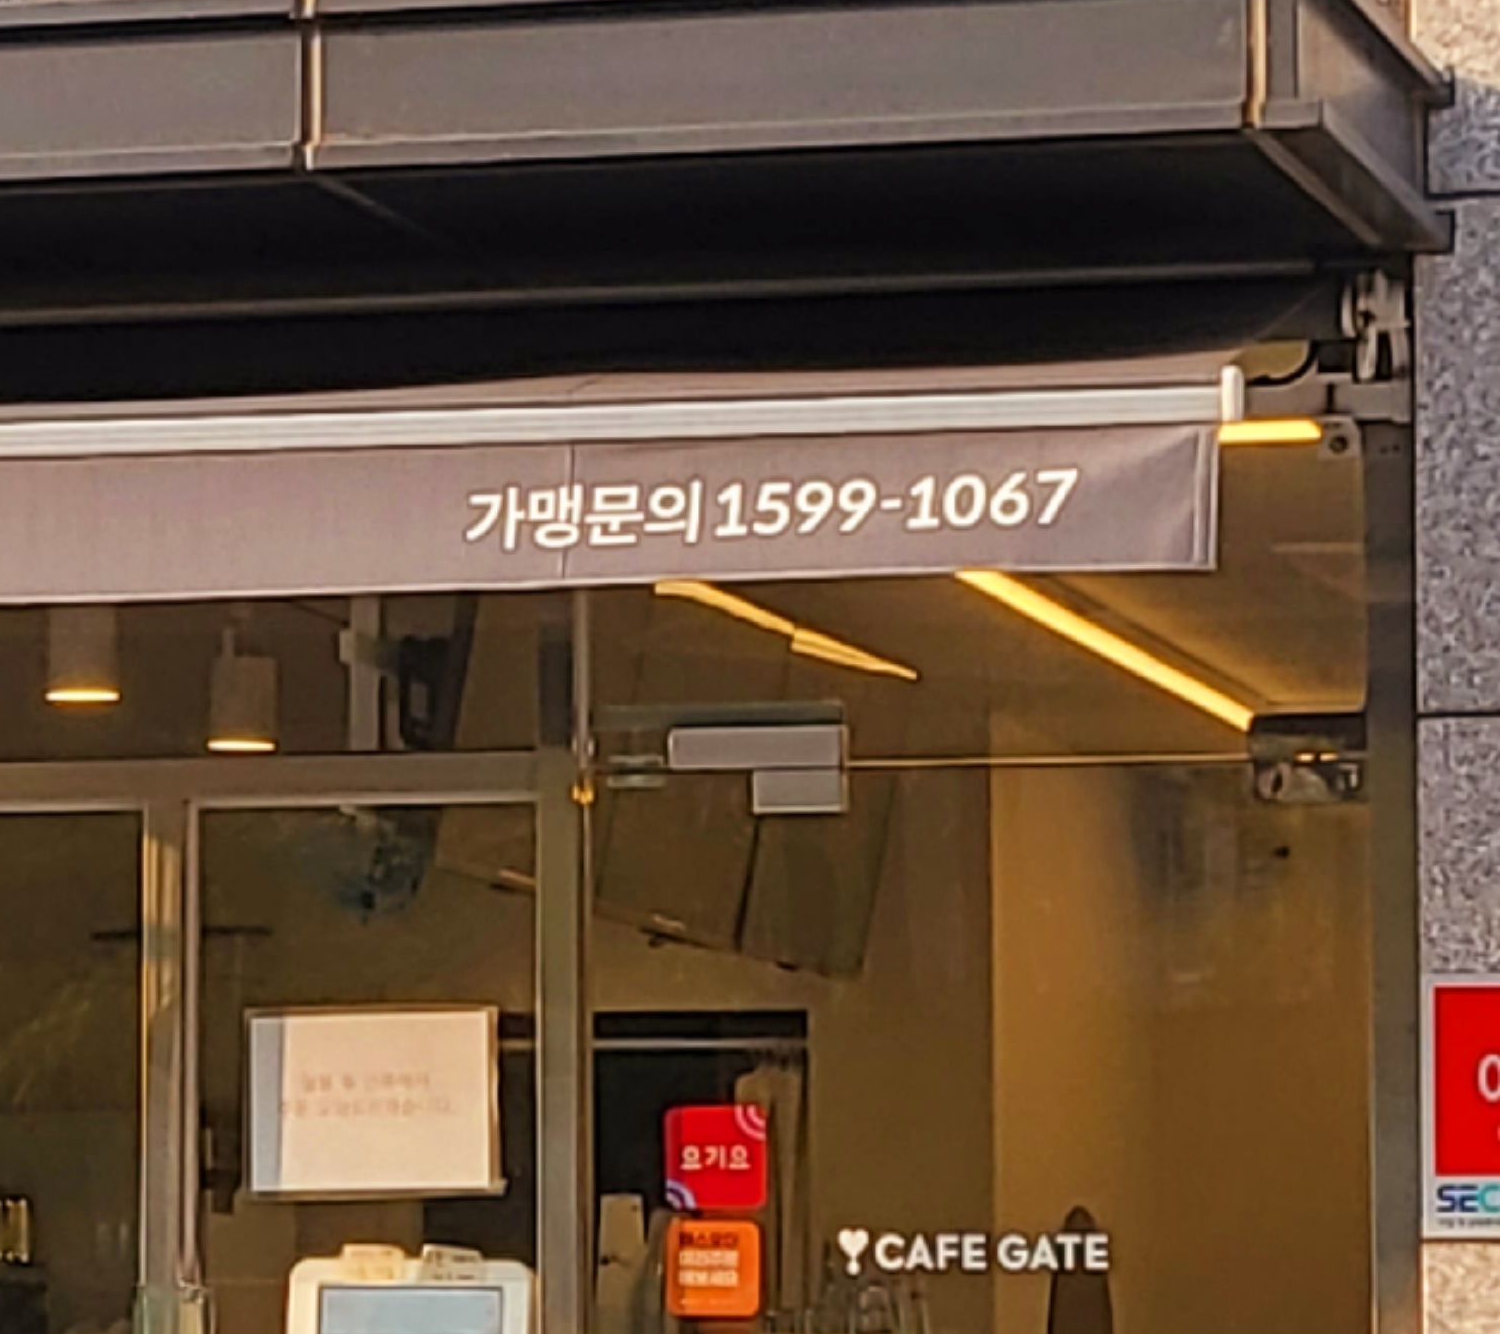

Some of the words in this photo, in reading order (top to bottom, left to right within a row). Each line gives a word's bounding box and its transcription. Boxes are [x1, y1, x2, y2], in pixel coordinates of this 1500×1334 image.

[465, 479, 702, 552] 가맹문의
[713, 468, 1078, 539] 1599-1067
[680, 1144, 751, 1170] 요기요
[874, 1233, 988, 1270] CAFE
[997, 1233, 1110, 1270] GATE
